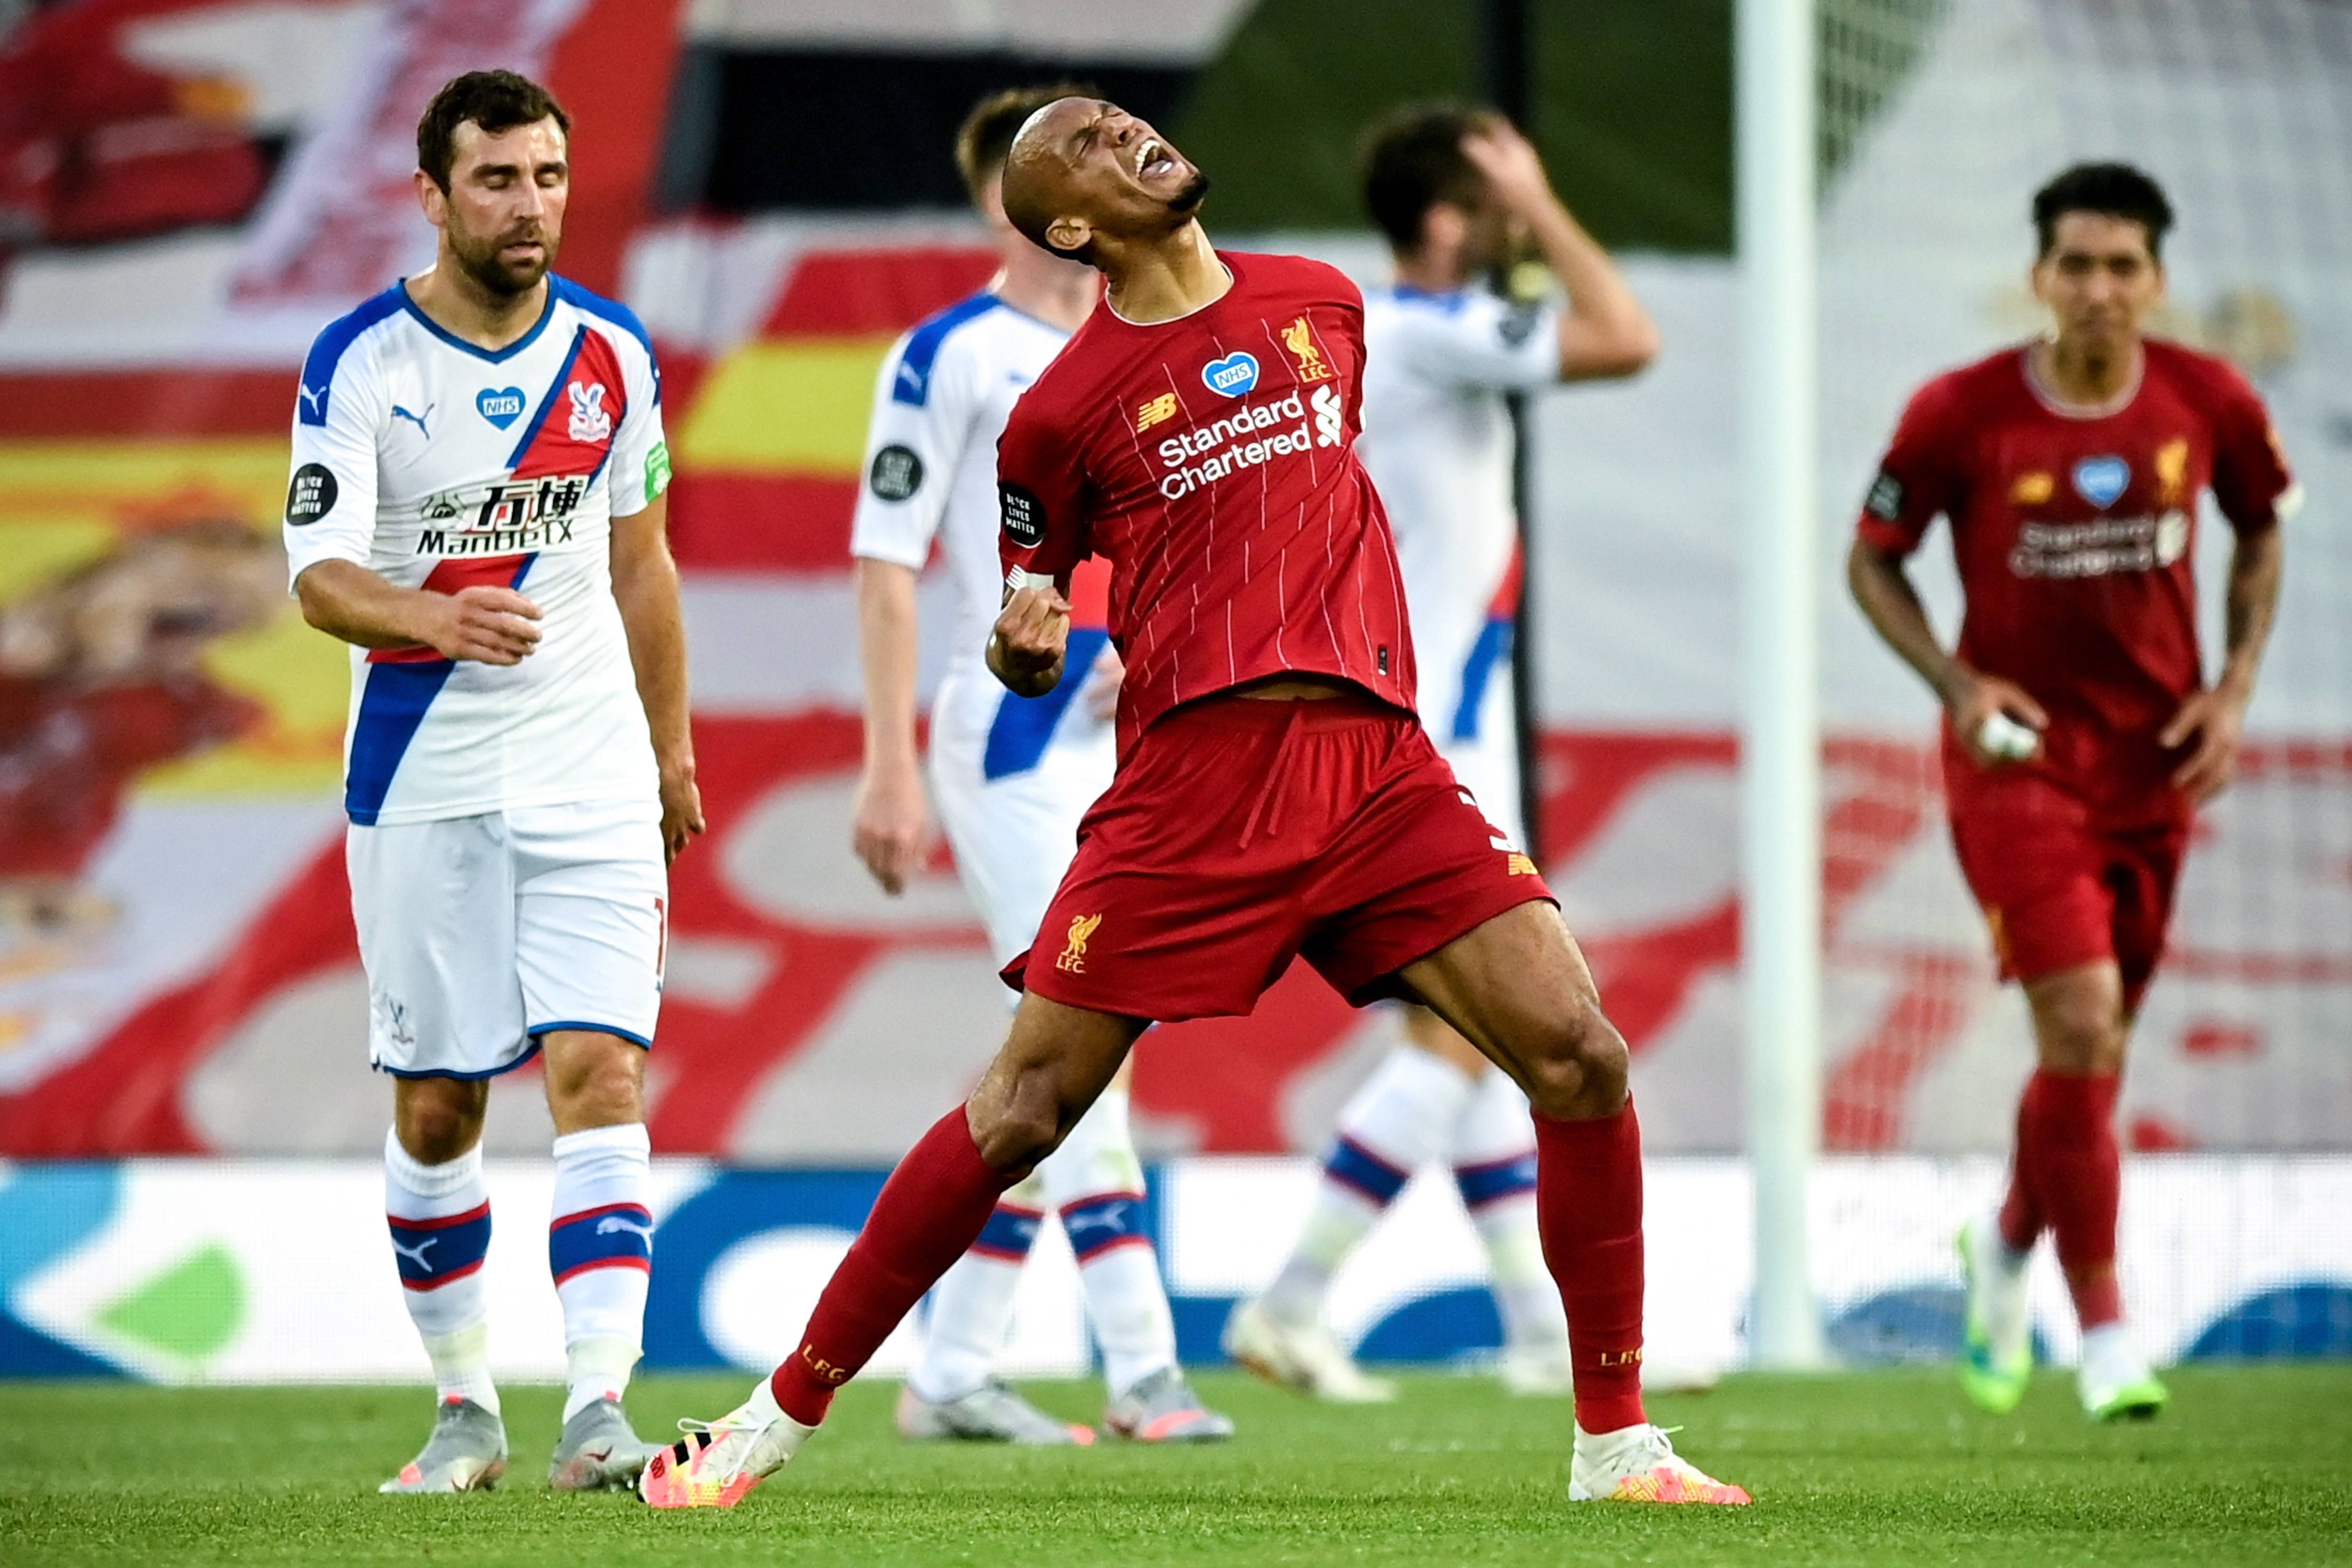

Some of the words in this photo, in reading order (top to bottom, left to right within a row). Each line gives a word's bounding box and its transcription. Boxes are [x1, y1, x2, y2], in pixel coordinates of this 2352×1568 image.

[1218, 367, 1252, 386] NHS
[1298, 364, 1332, 383] LFC
[486, 400, 516, 413] NHS
[1159, 389, 1305, 467] Standard
[1160, 422, 1312, 500] Chartered
[1008, 506, 1030, 522] LIVES
[1006, 516, 1035, 535] MATTER
[1055, 955, 1086, 974] LFC
[803, 1343, 846, 1380] LFC
